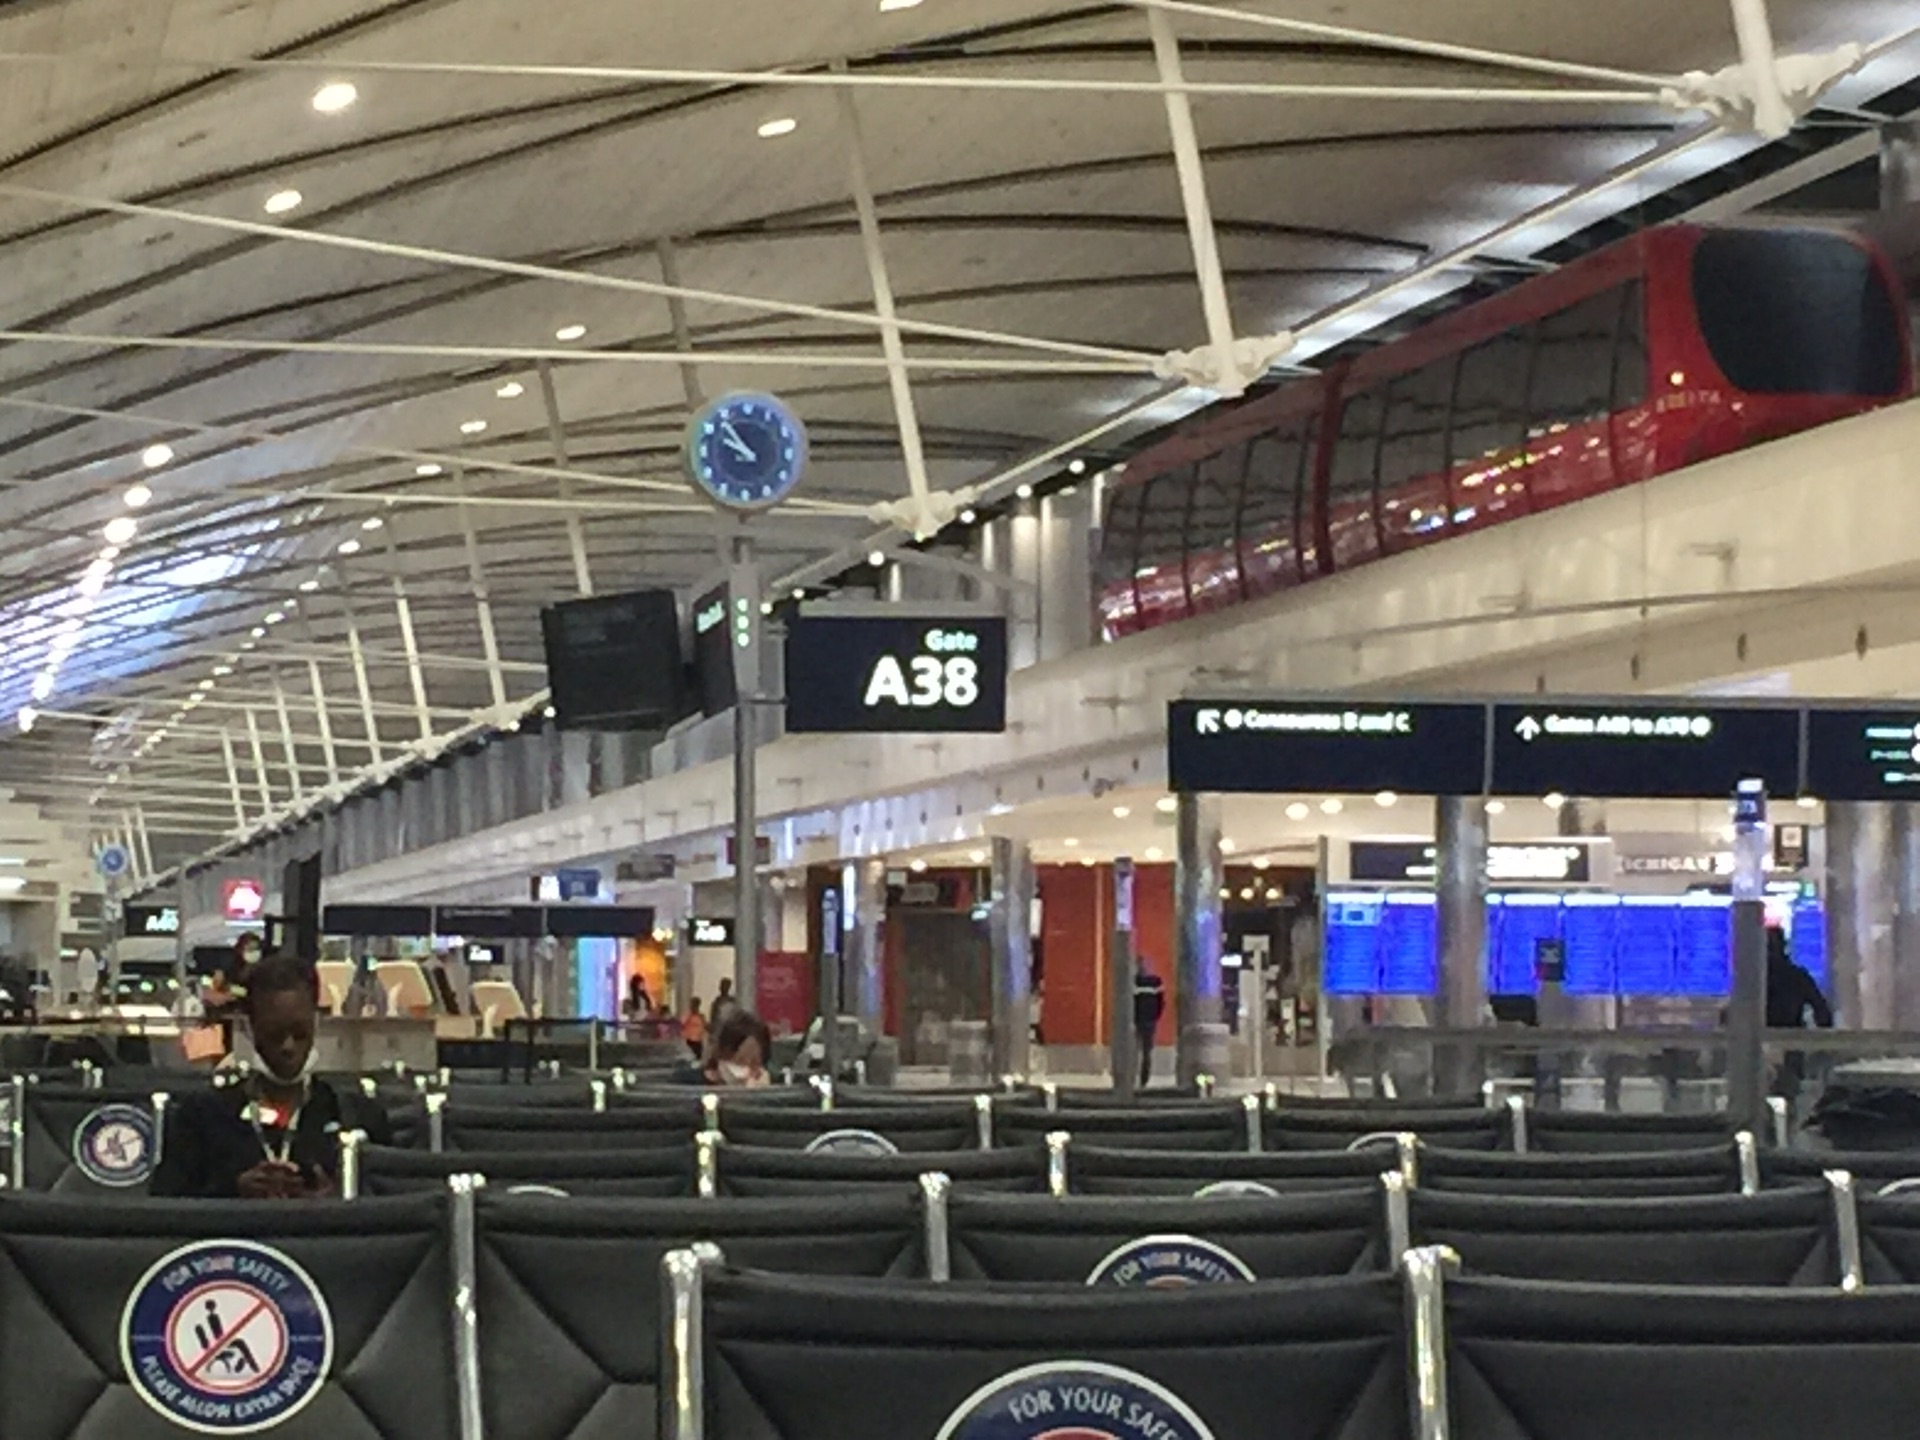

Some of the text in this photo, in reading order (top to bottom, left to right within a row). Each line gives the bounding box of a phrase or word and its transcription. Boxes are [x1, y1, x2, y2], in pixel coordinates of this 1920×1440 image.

[925, 628, 978, 651] Gate
[864, 655, 978, 706] A38
[162, 1256, 290, 1292] FOR YOUR SAFETY
[1112, 1260, 1142, 1287] FOR
[1138, 1252, 1181, 1269] YOUR
[142, 1355, 182, 1400] PLEASE
[178, 1396, 230, 1418] ALLOW
[235, 1391, 284, 1418] EXTRA
[1008, 1389, 1055, 1423] FOR
[1057, 1386, 1123, 1420] YOUR
